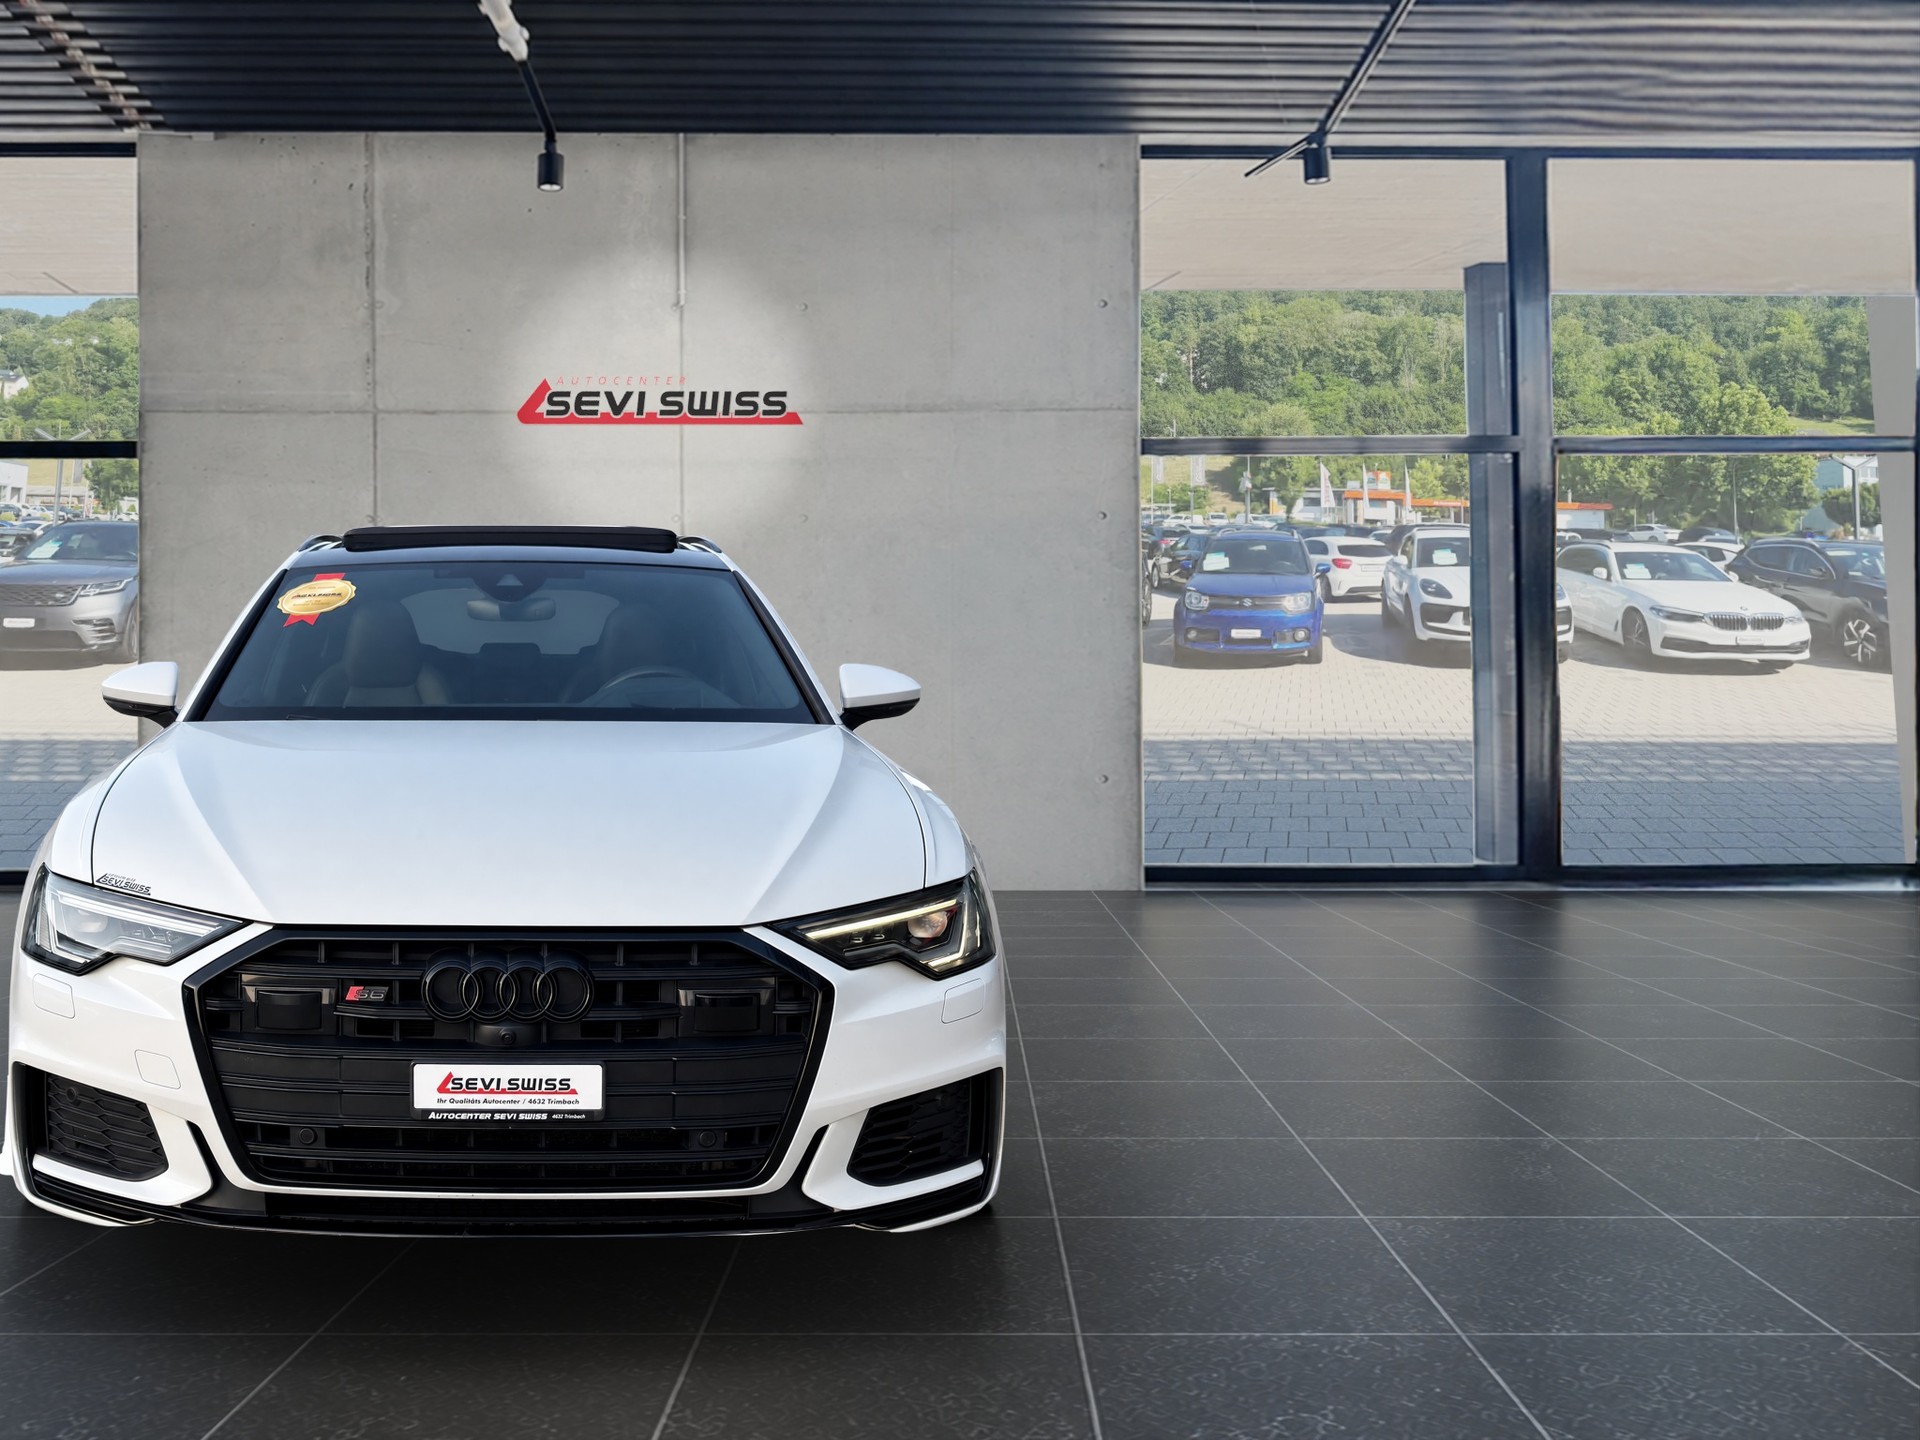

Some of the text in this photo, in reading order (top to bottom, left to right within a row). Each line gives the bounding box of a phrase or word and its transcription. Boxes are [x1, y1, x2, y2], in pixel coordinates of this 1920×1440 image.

[556, 376, 687, 386] AUTOCENTER
[545, 390, 788, 416] SEVI SWISS
[101, 876, 124, 886] SEVI
[123, 881, 152, 893] SWISS
[354, 989, 386, 999] S6
[451, 1077, 571, 1091] SEVI SWISS
[493, 1112, 517, 1120] SEVI
[518, 1112, 548, 1120] SWISS
